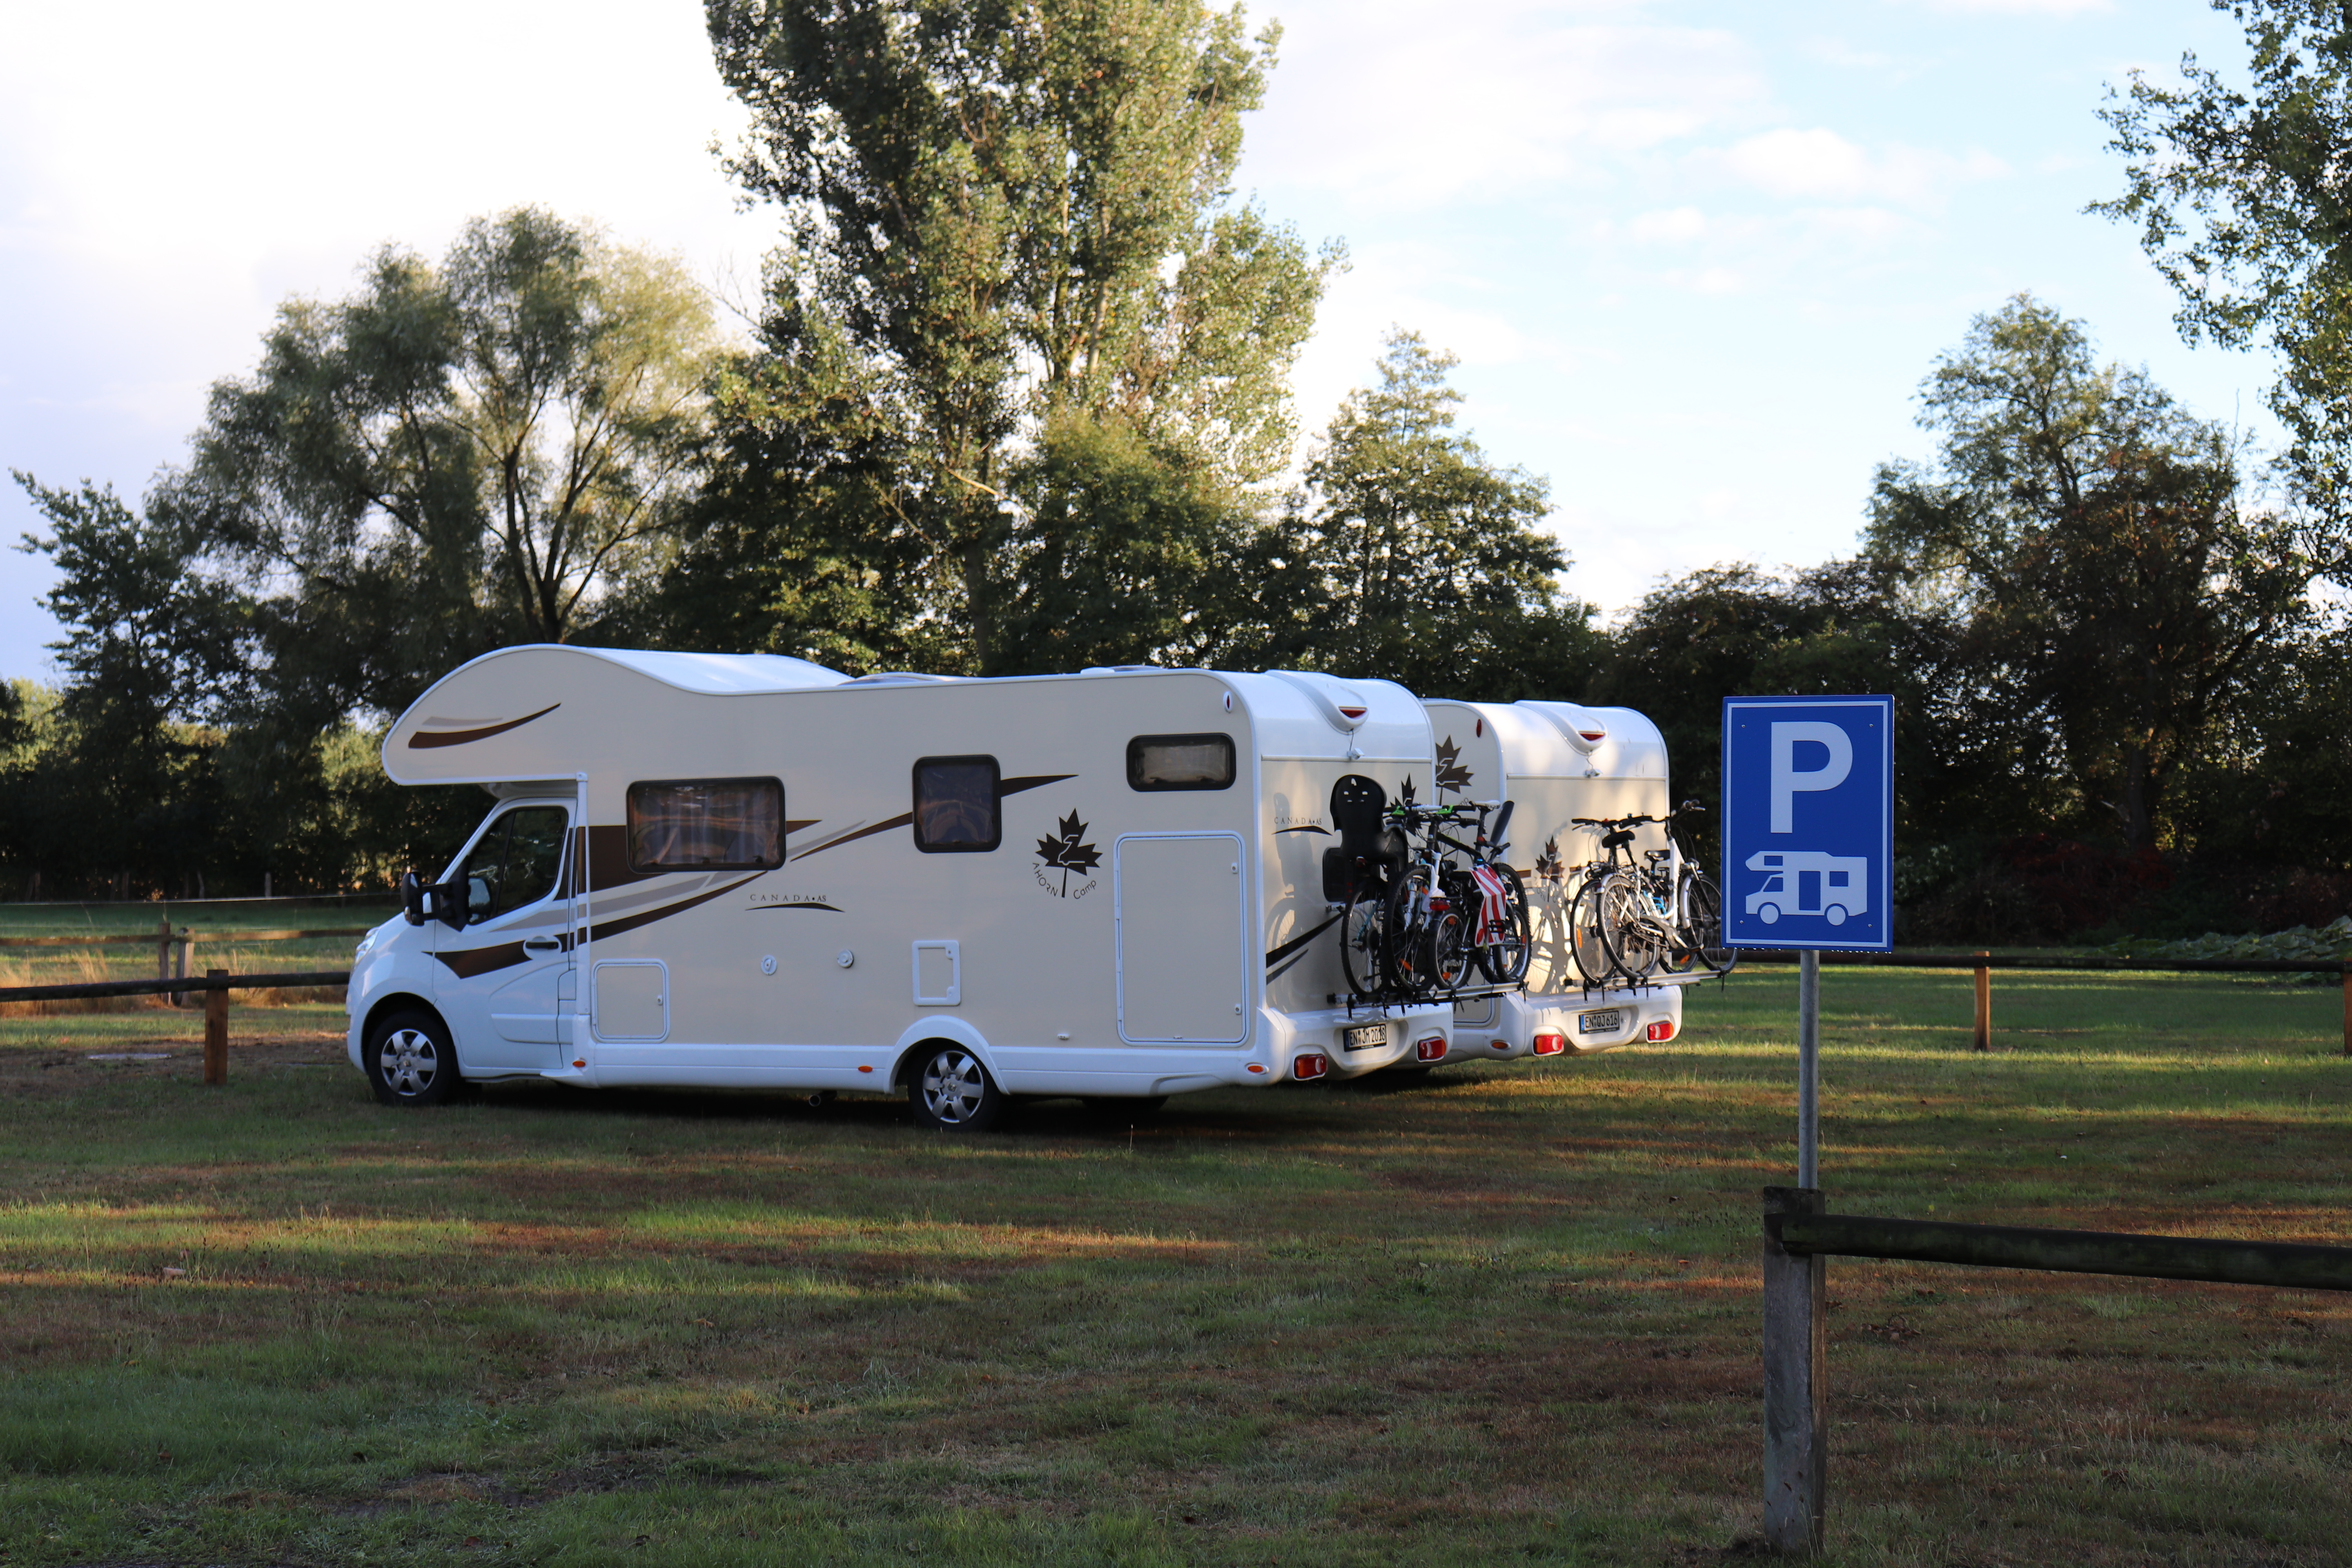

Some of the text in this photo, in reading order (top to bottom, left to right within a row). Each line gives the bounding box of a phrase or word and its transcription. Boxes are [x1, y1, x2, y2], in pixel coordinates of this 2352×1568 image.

[1770, 721, 1853, 833] P
[1032, 862, 1097, 900] AHORN Camp
[1585, 1016, 1593, 1028] EN
[1606, 1014, 1618, 1026] 616
[1349, 1031, 1357, 1046] EN
[1371, 1027, 1385, 1042] 2018
